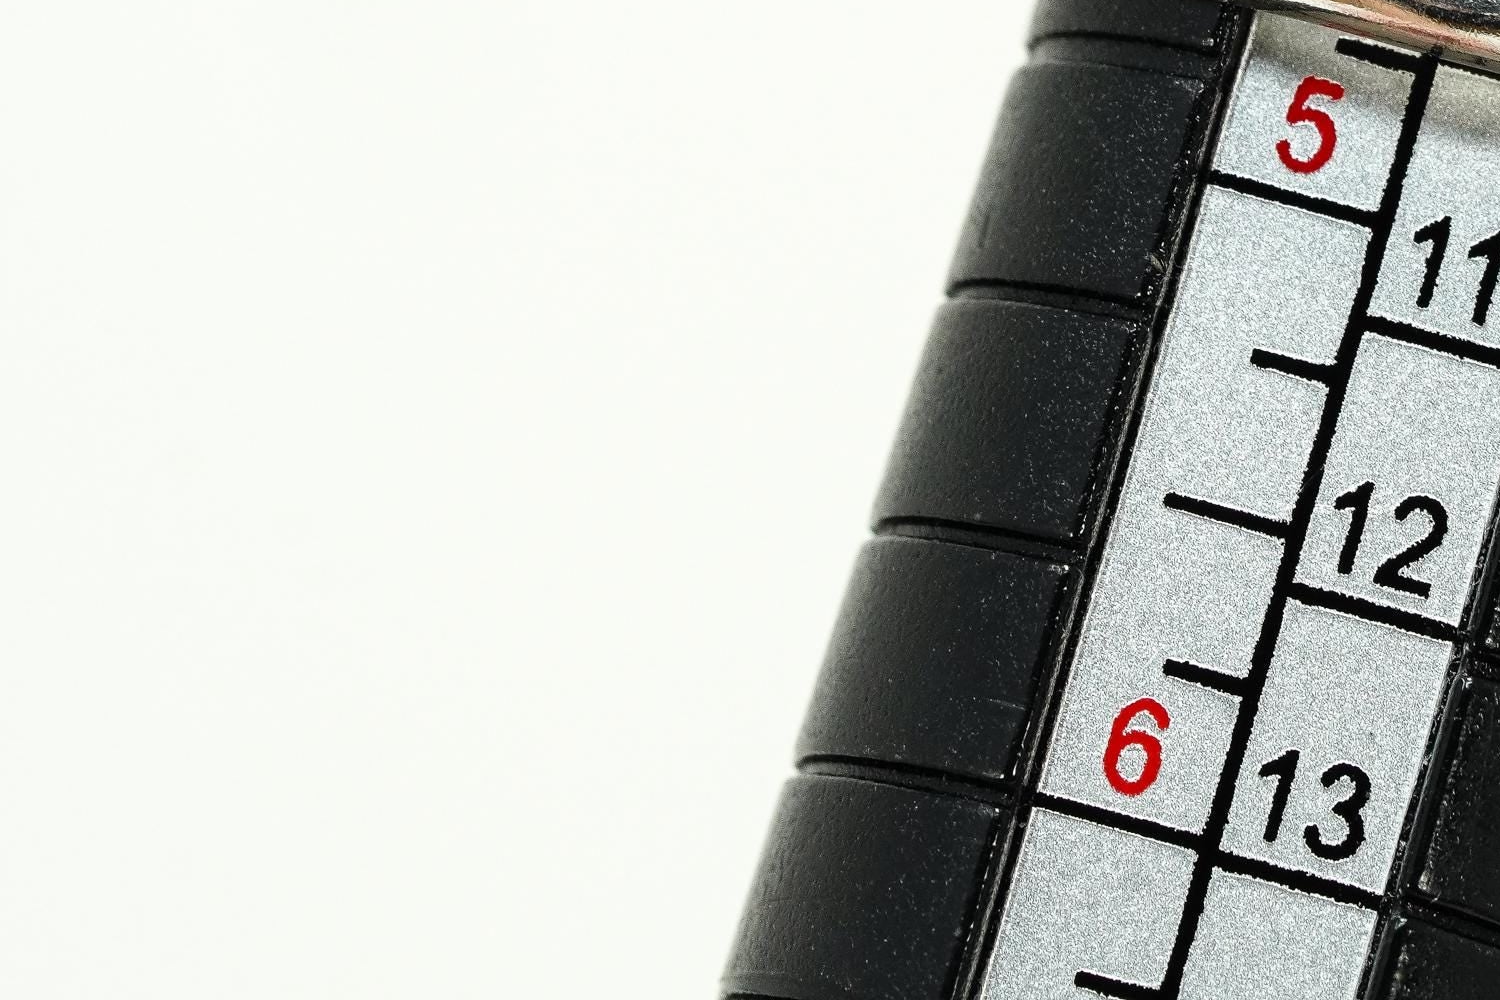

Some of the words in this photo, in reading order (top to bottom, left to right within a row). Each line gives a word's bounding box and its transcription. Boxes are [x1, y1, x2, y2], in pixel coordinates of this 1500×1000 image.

[1275, 75, 1346, 175] 5
[1333, 480, 1450, 600] 12
[1102, 697, 1171, 798] 6
[1257, 749, 1372, 862] 13
